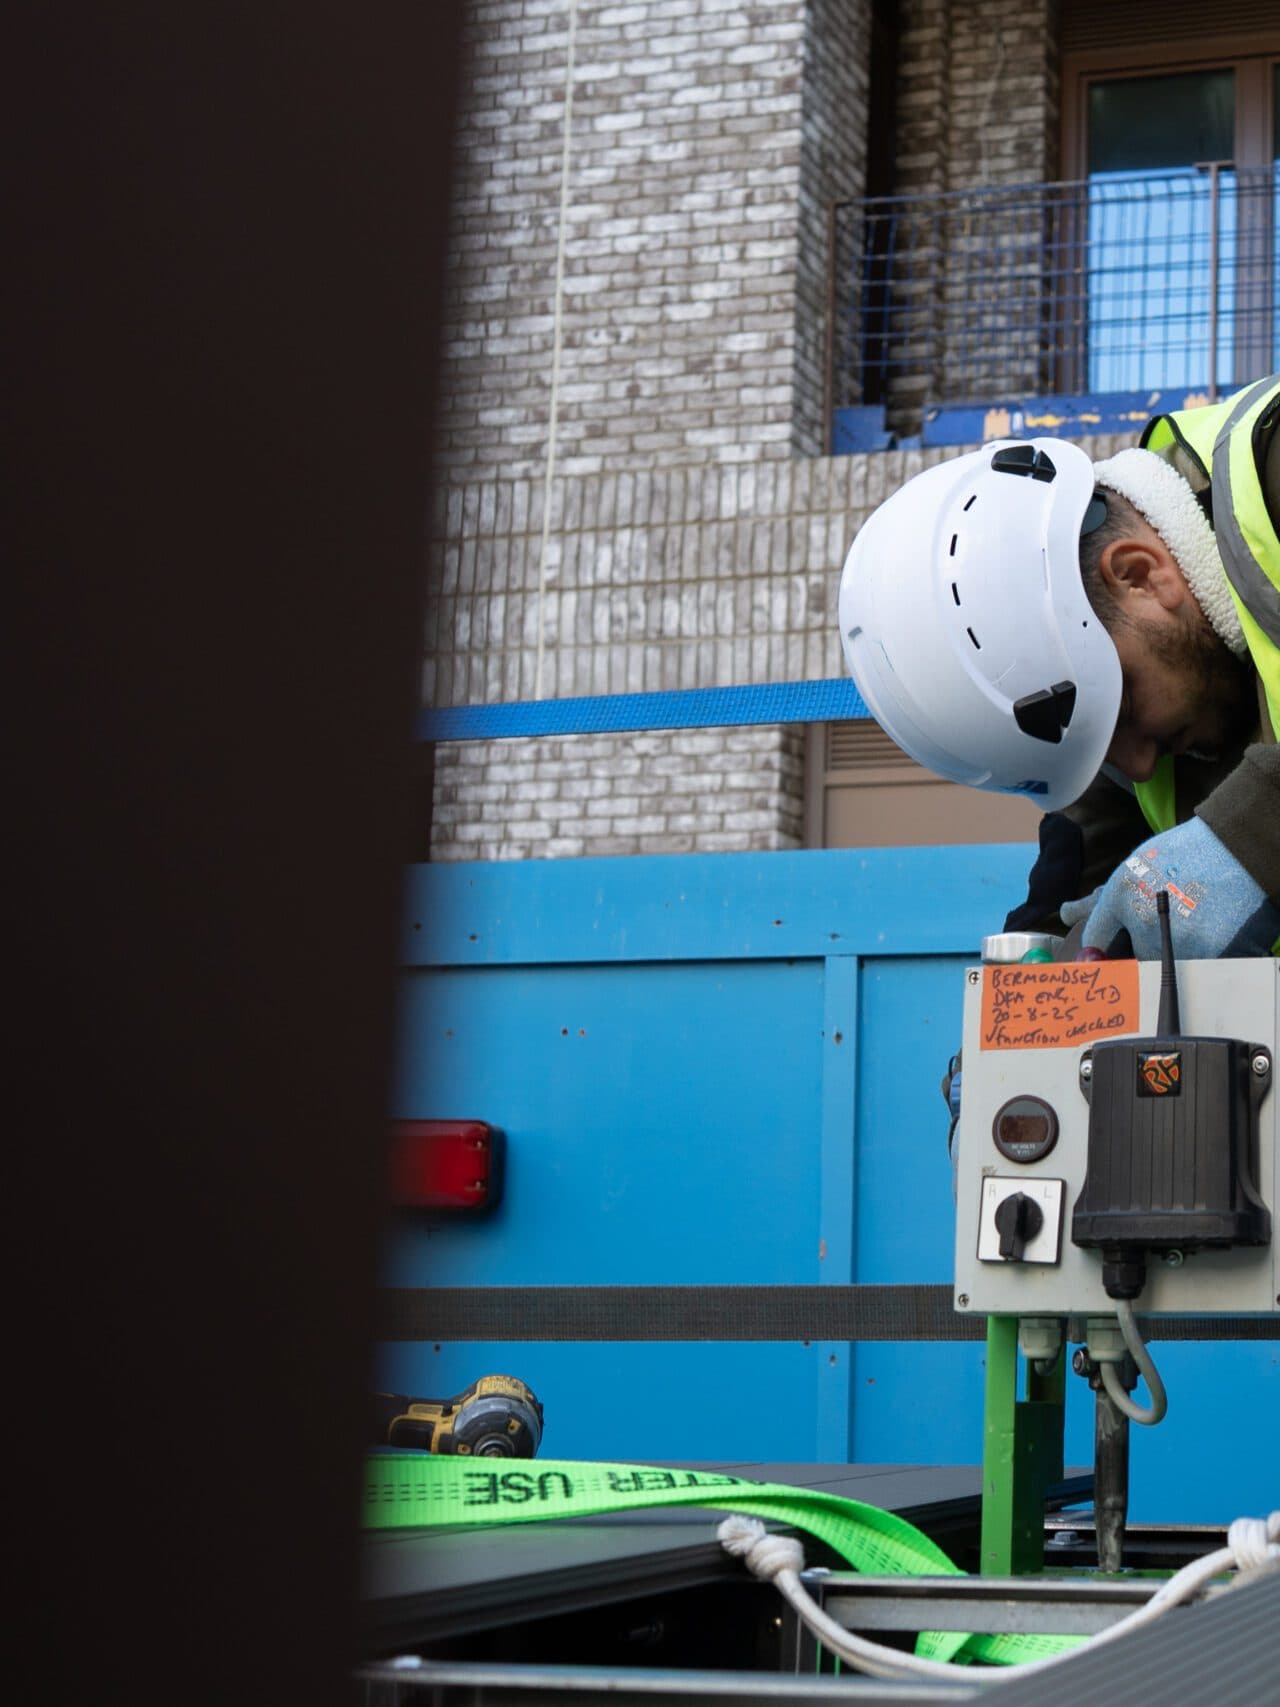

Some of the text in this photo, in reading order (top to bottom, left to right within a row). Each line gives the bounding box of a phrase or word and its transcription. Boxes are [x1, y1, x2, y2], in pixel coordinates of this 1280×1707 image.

[992, 968, 1100, 988] BERMONDSEY
[1086, 985, 1121, 1004] LTD
[463, 1471, 573, 1506] USE
